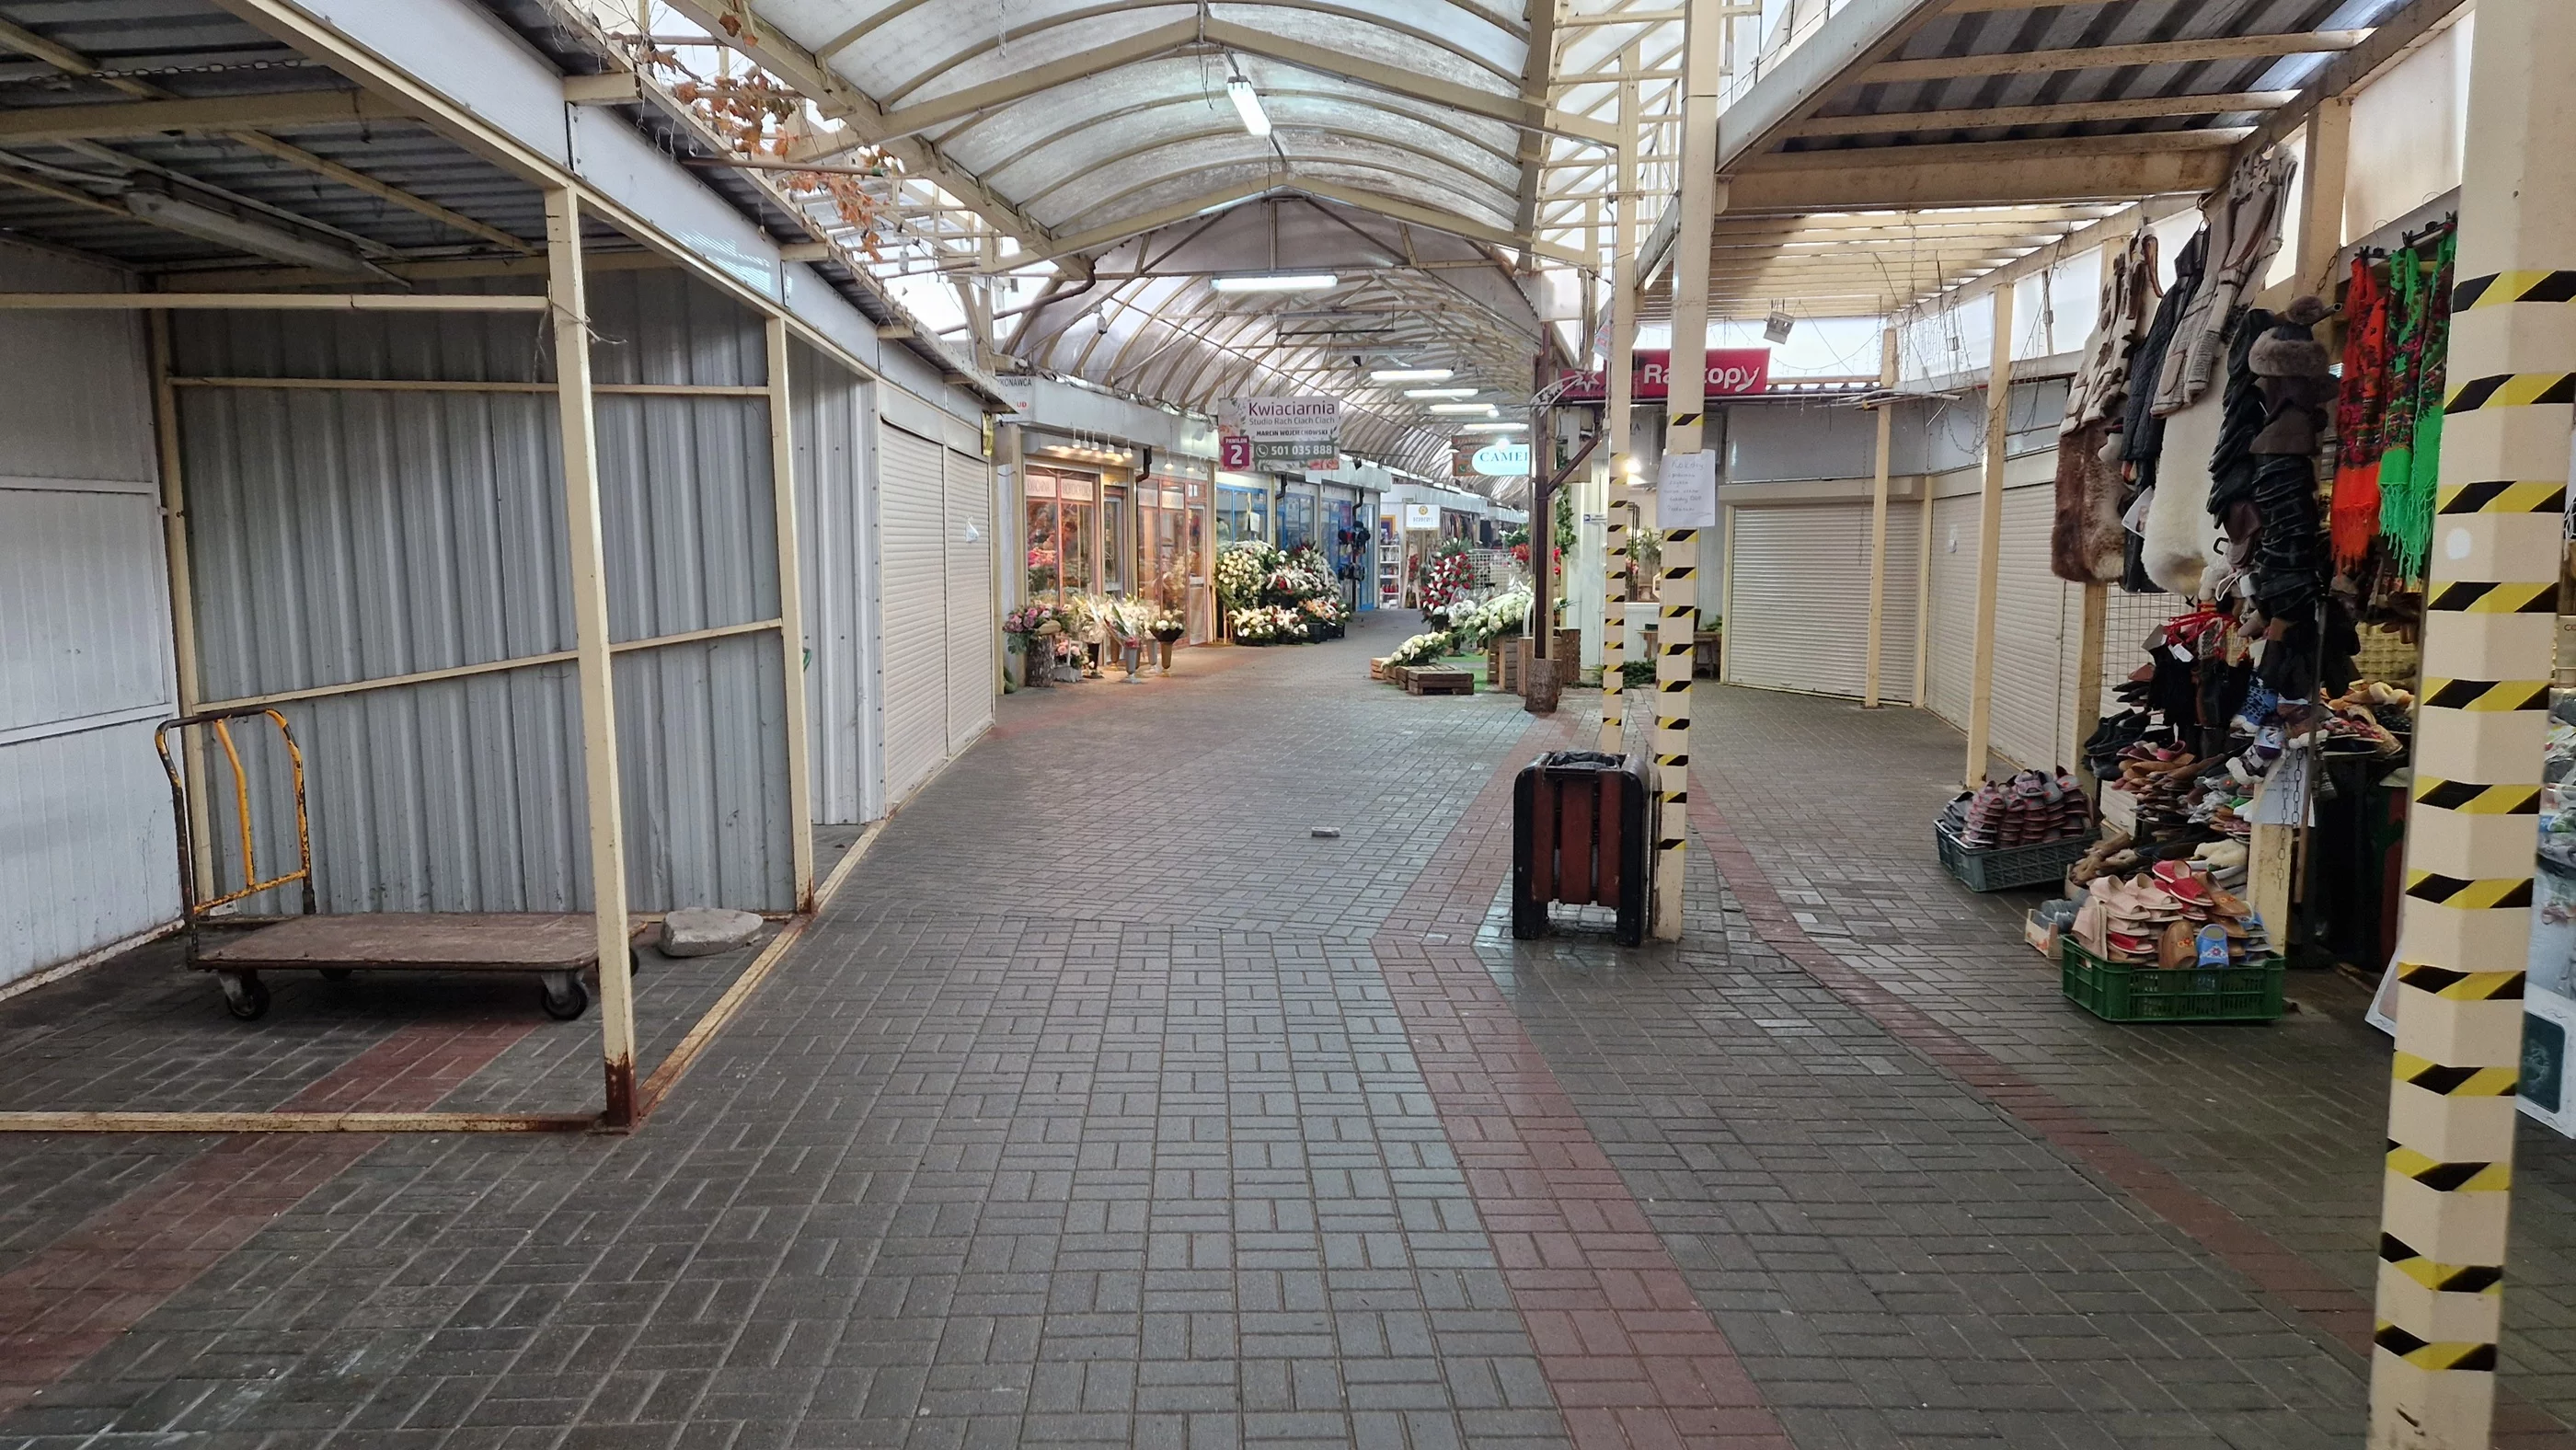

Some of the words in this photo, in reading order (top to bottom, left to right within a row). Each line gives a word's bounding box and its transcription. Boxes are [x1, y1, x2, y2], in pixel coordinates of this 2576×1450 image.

[999, 378, 1032, 386] KONAWCA
[1644, 363, 1760, 392] Raopy
[1248, 400, 1335, 416] Kwiaciarnia
[1230, 444, 1243, 465] 2
[1271, 445, 1289, 455] 501
[1292, 445, 1311, 455] 035
[1313, 444, 1333, 455] 888
